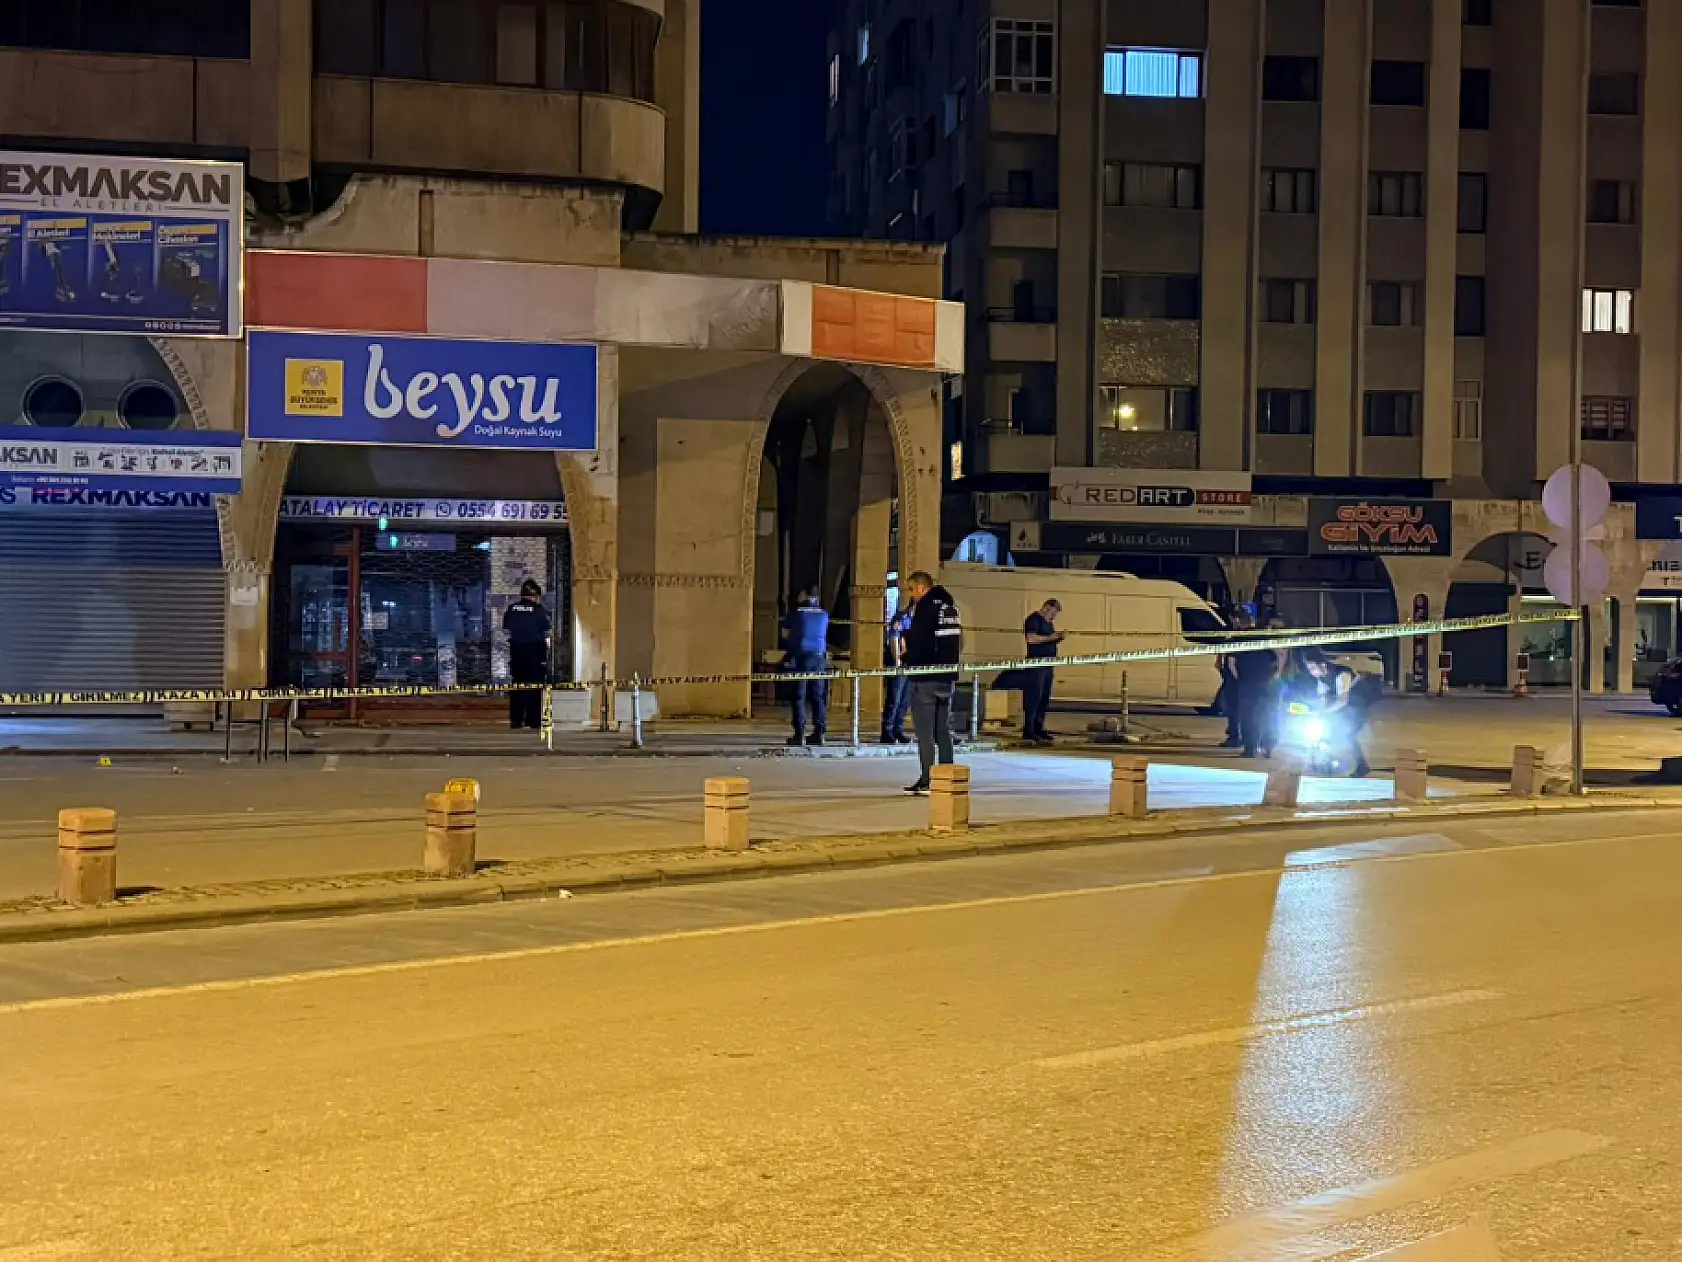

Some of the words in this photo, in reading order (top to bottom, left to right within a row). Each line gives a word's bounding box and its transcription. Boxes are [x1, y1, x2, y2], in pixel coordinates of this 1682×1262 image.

[363, 343, 563, 438] beysu
[474, 424, 502, 437] Doğal
[504, 426, 538, 439] Kaynak
[539, 426, 562, 439] Suyu
[31, 488, 212, 507] REXMAKSAN
[502, 503, 525, 519] 691
[531, 503, 549, 519] 69
[1337, 501, 1424, 523] GÖKSU
